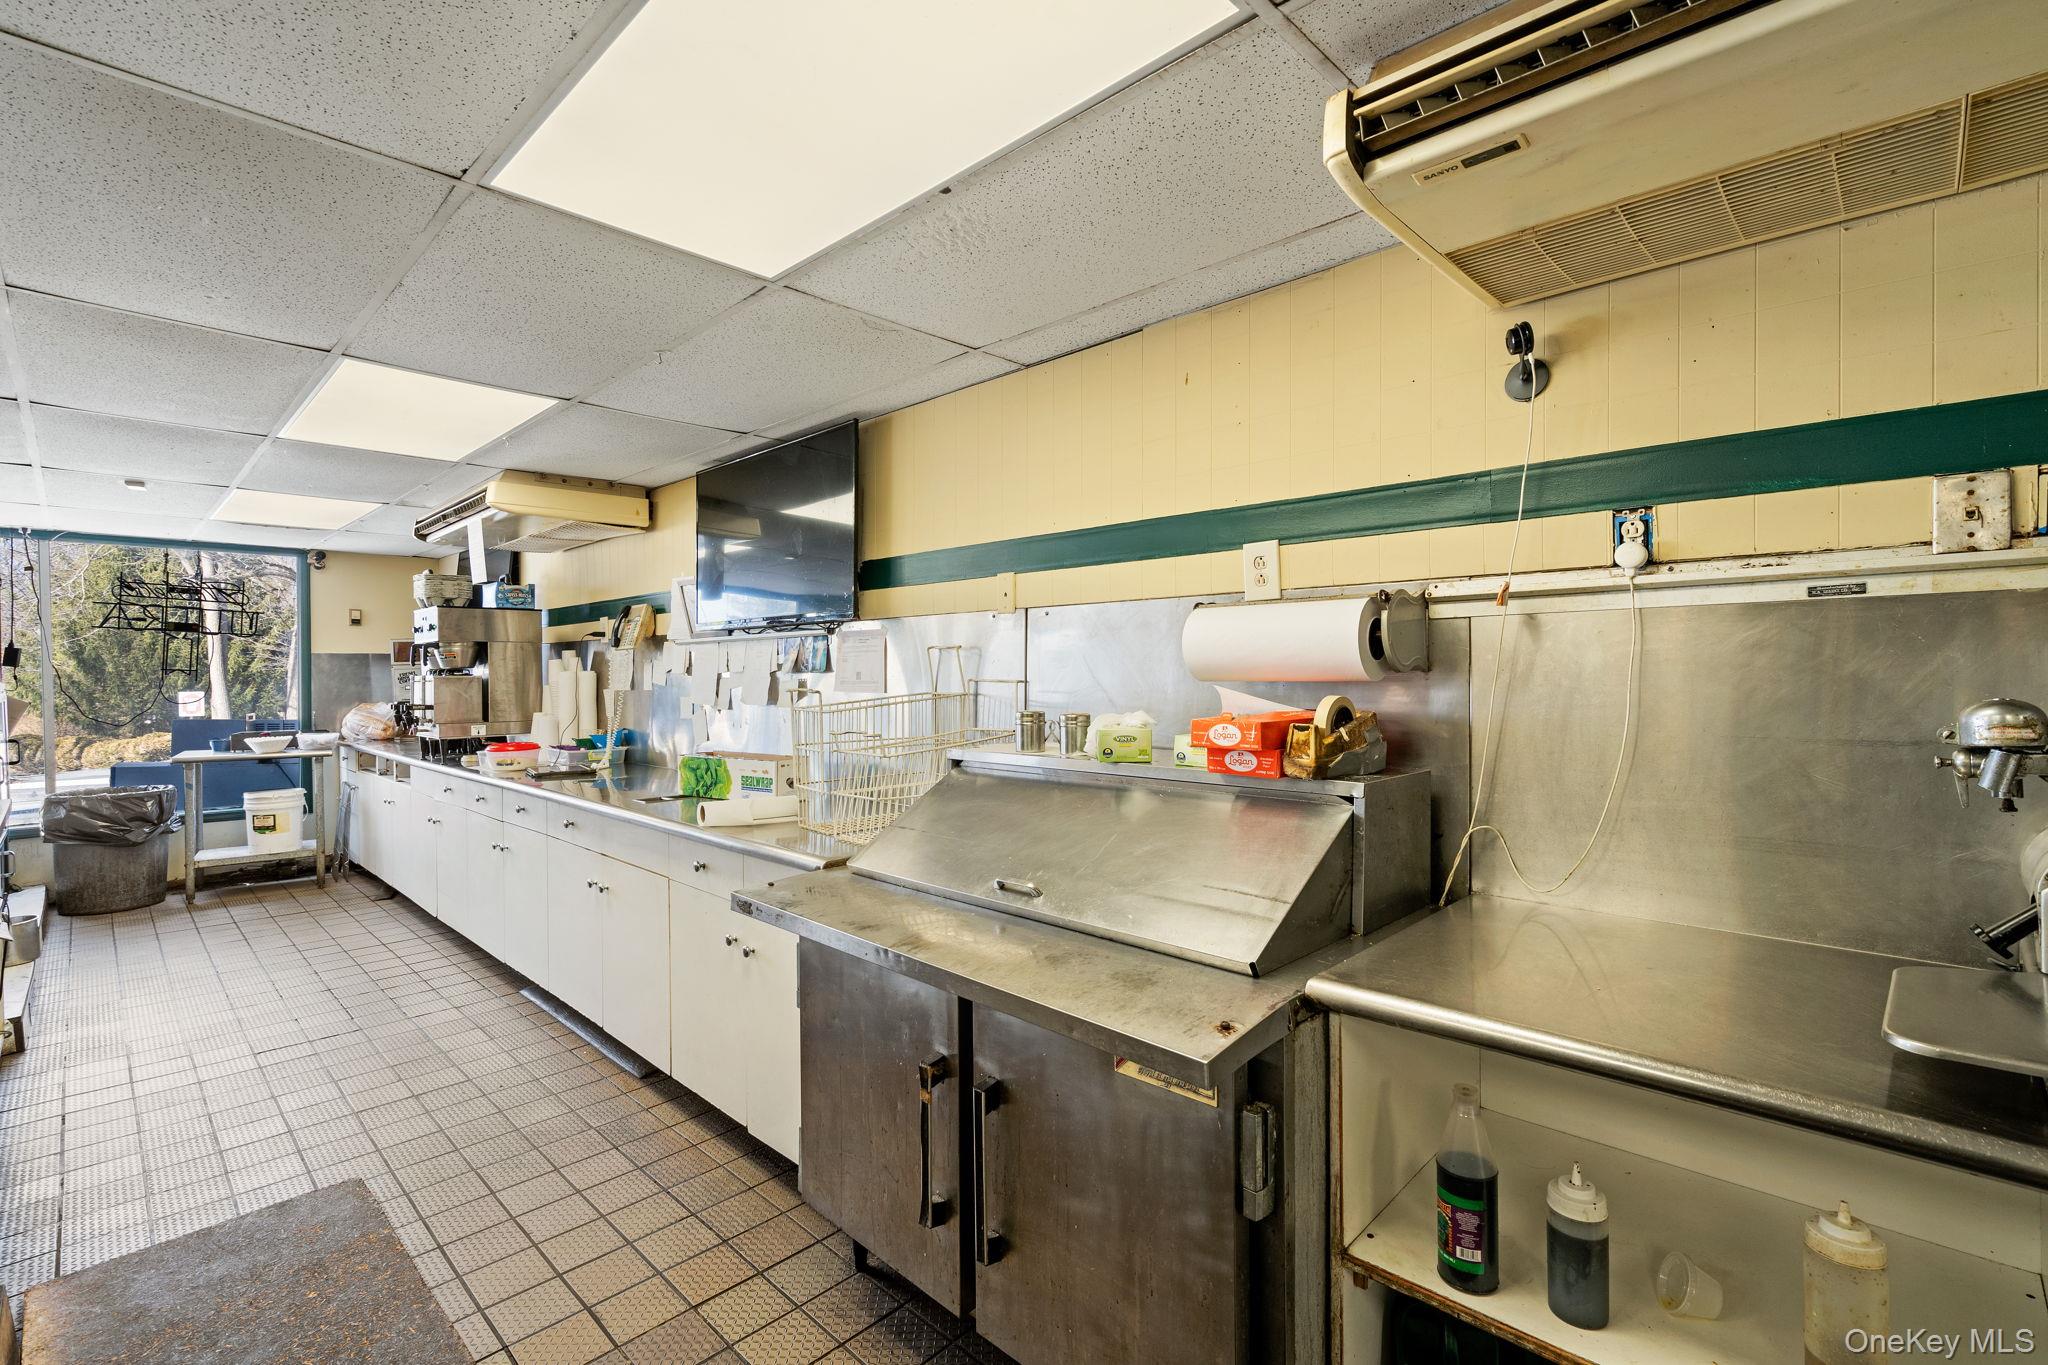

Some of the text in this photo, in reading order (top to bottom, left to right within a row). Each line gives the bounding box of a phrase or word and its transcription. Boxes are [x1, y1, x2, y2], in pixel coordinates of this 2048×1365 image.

[1423, 165, 1459, 181] SANYO
[1213, 729, 1238, 741] Logan
[1228, 754, 1254, 766] Logan
